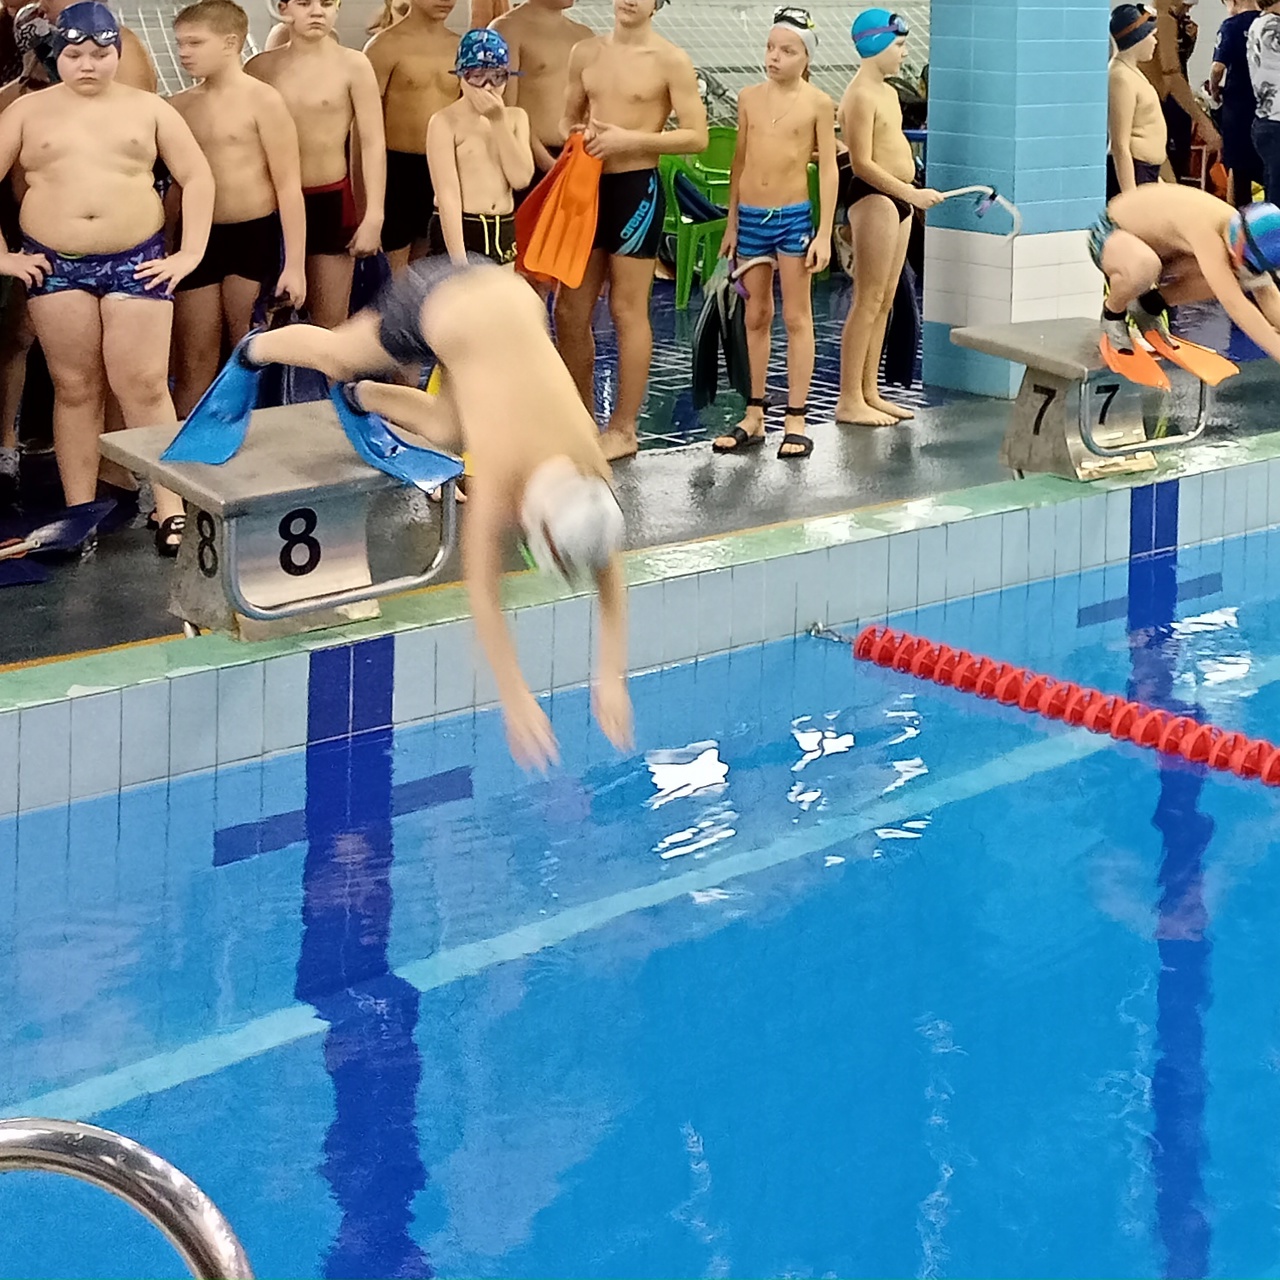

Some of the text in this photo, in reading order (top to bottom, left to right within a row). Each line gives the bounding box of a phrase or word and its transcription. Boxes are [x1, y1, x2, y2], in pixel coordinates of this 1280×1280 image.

[620, 199, 650, 239] arena
[1033, 384, 1057, 436] 7
[1095, 383, 1120, 425] 7
[197, 510, 218, 578] 8
[278, 507, 321, 577] 8
